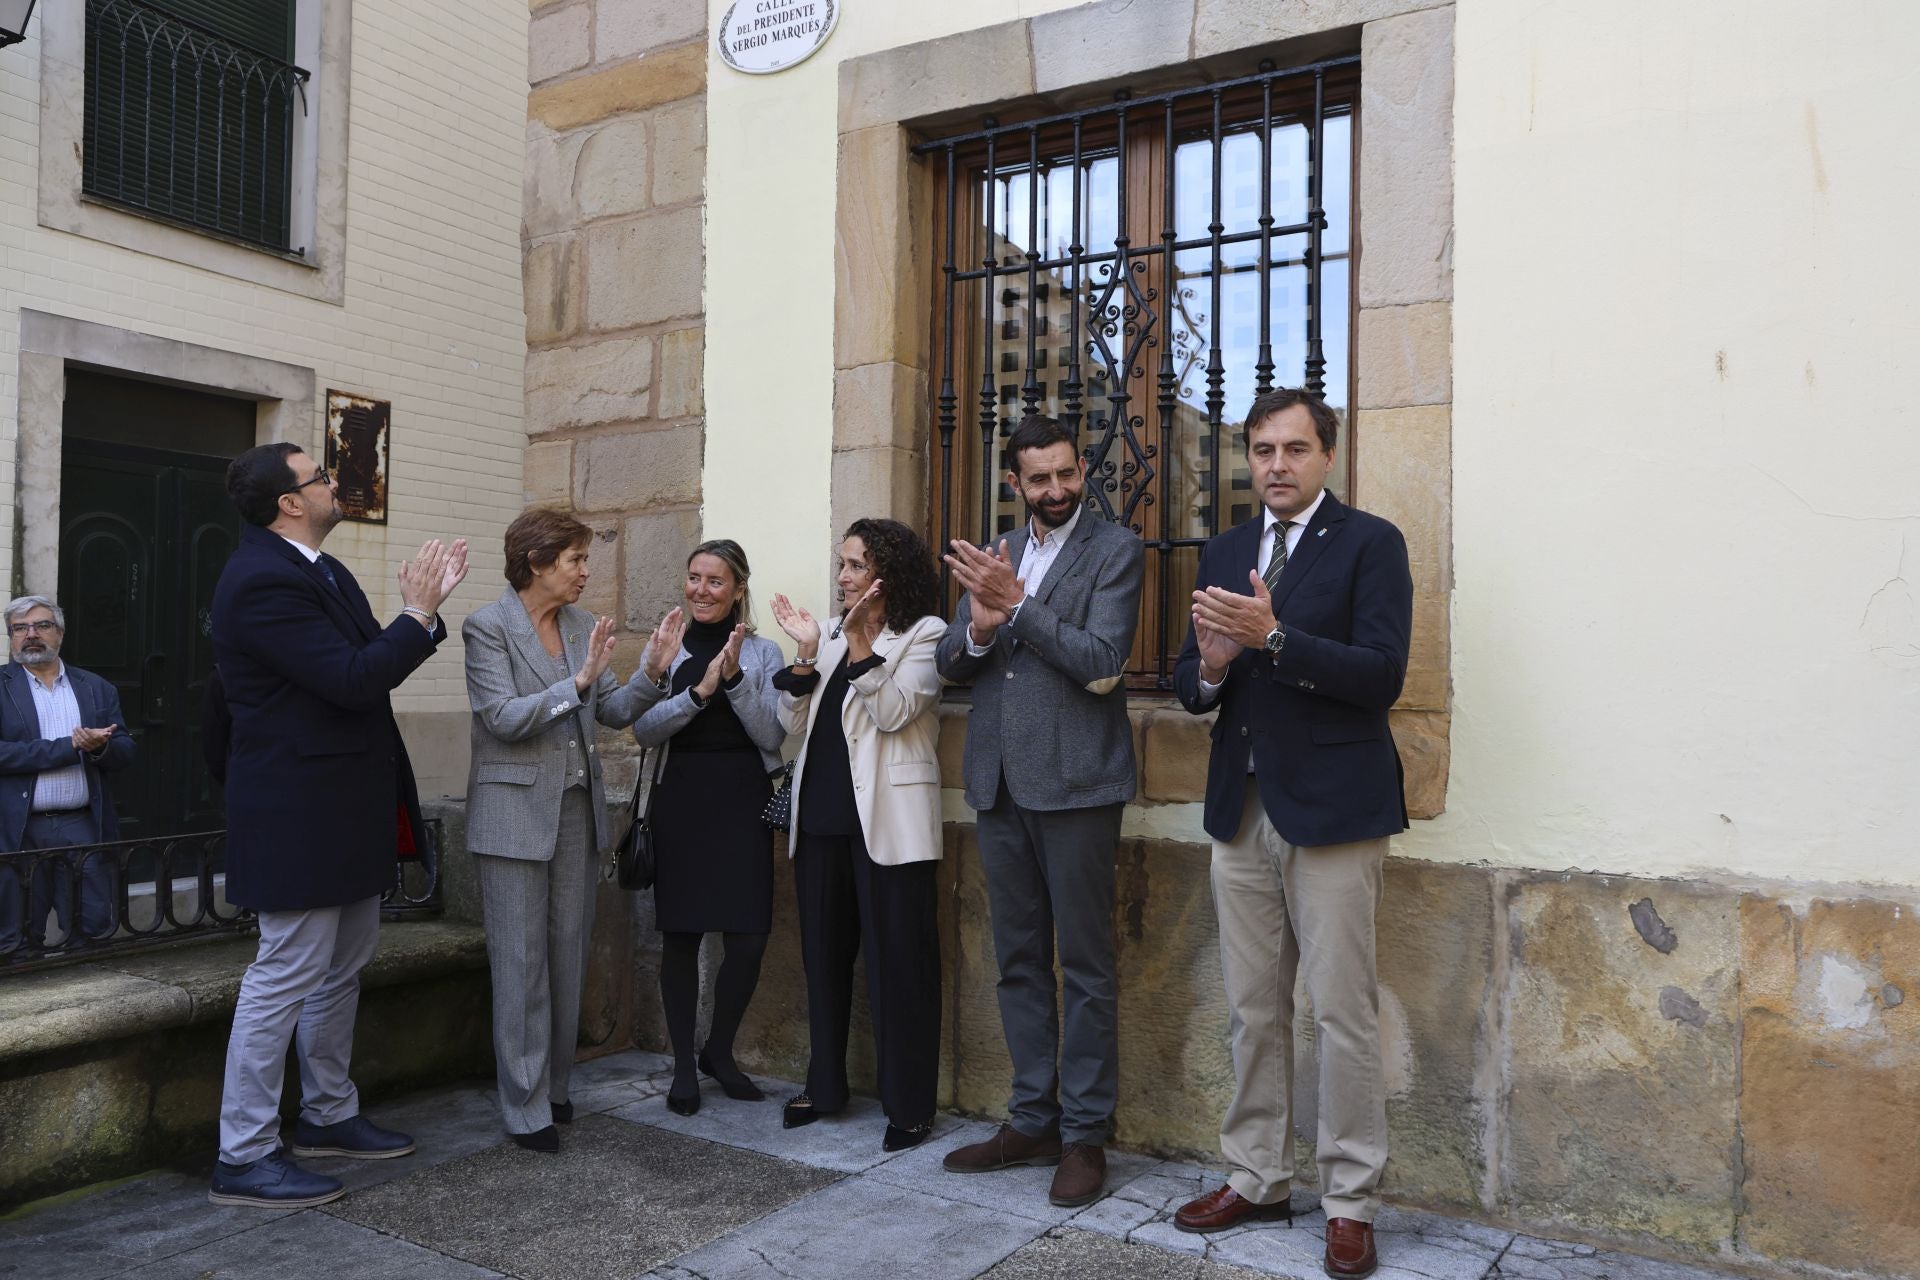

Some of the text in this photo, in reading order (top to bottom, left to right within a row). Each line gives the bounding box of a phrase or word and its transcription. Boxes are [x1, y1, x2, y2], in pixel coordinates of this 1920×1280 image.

[732, 18, 820, 53] SERGIO MARQUÉS
[737, 3, 815, 36] DEL PRESIDENTE
